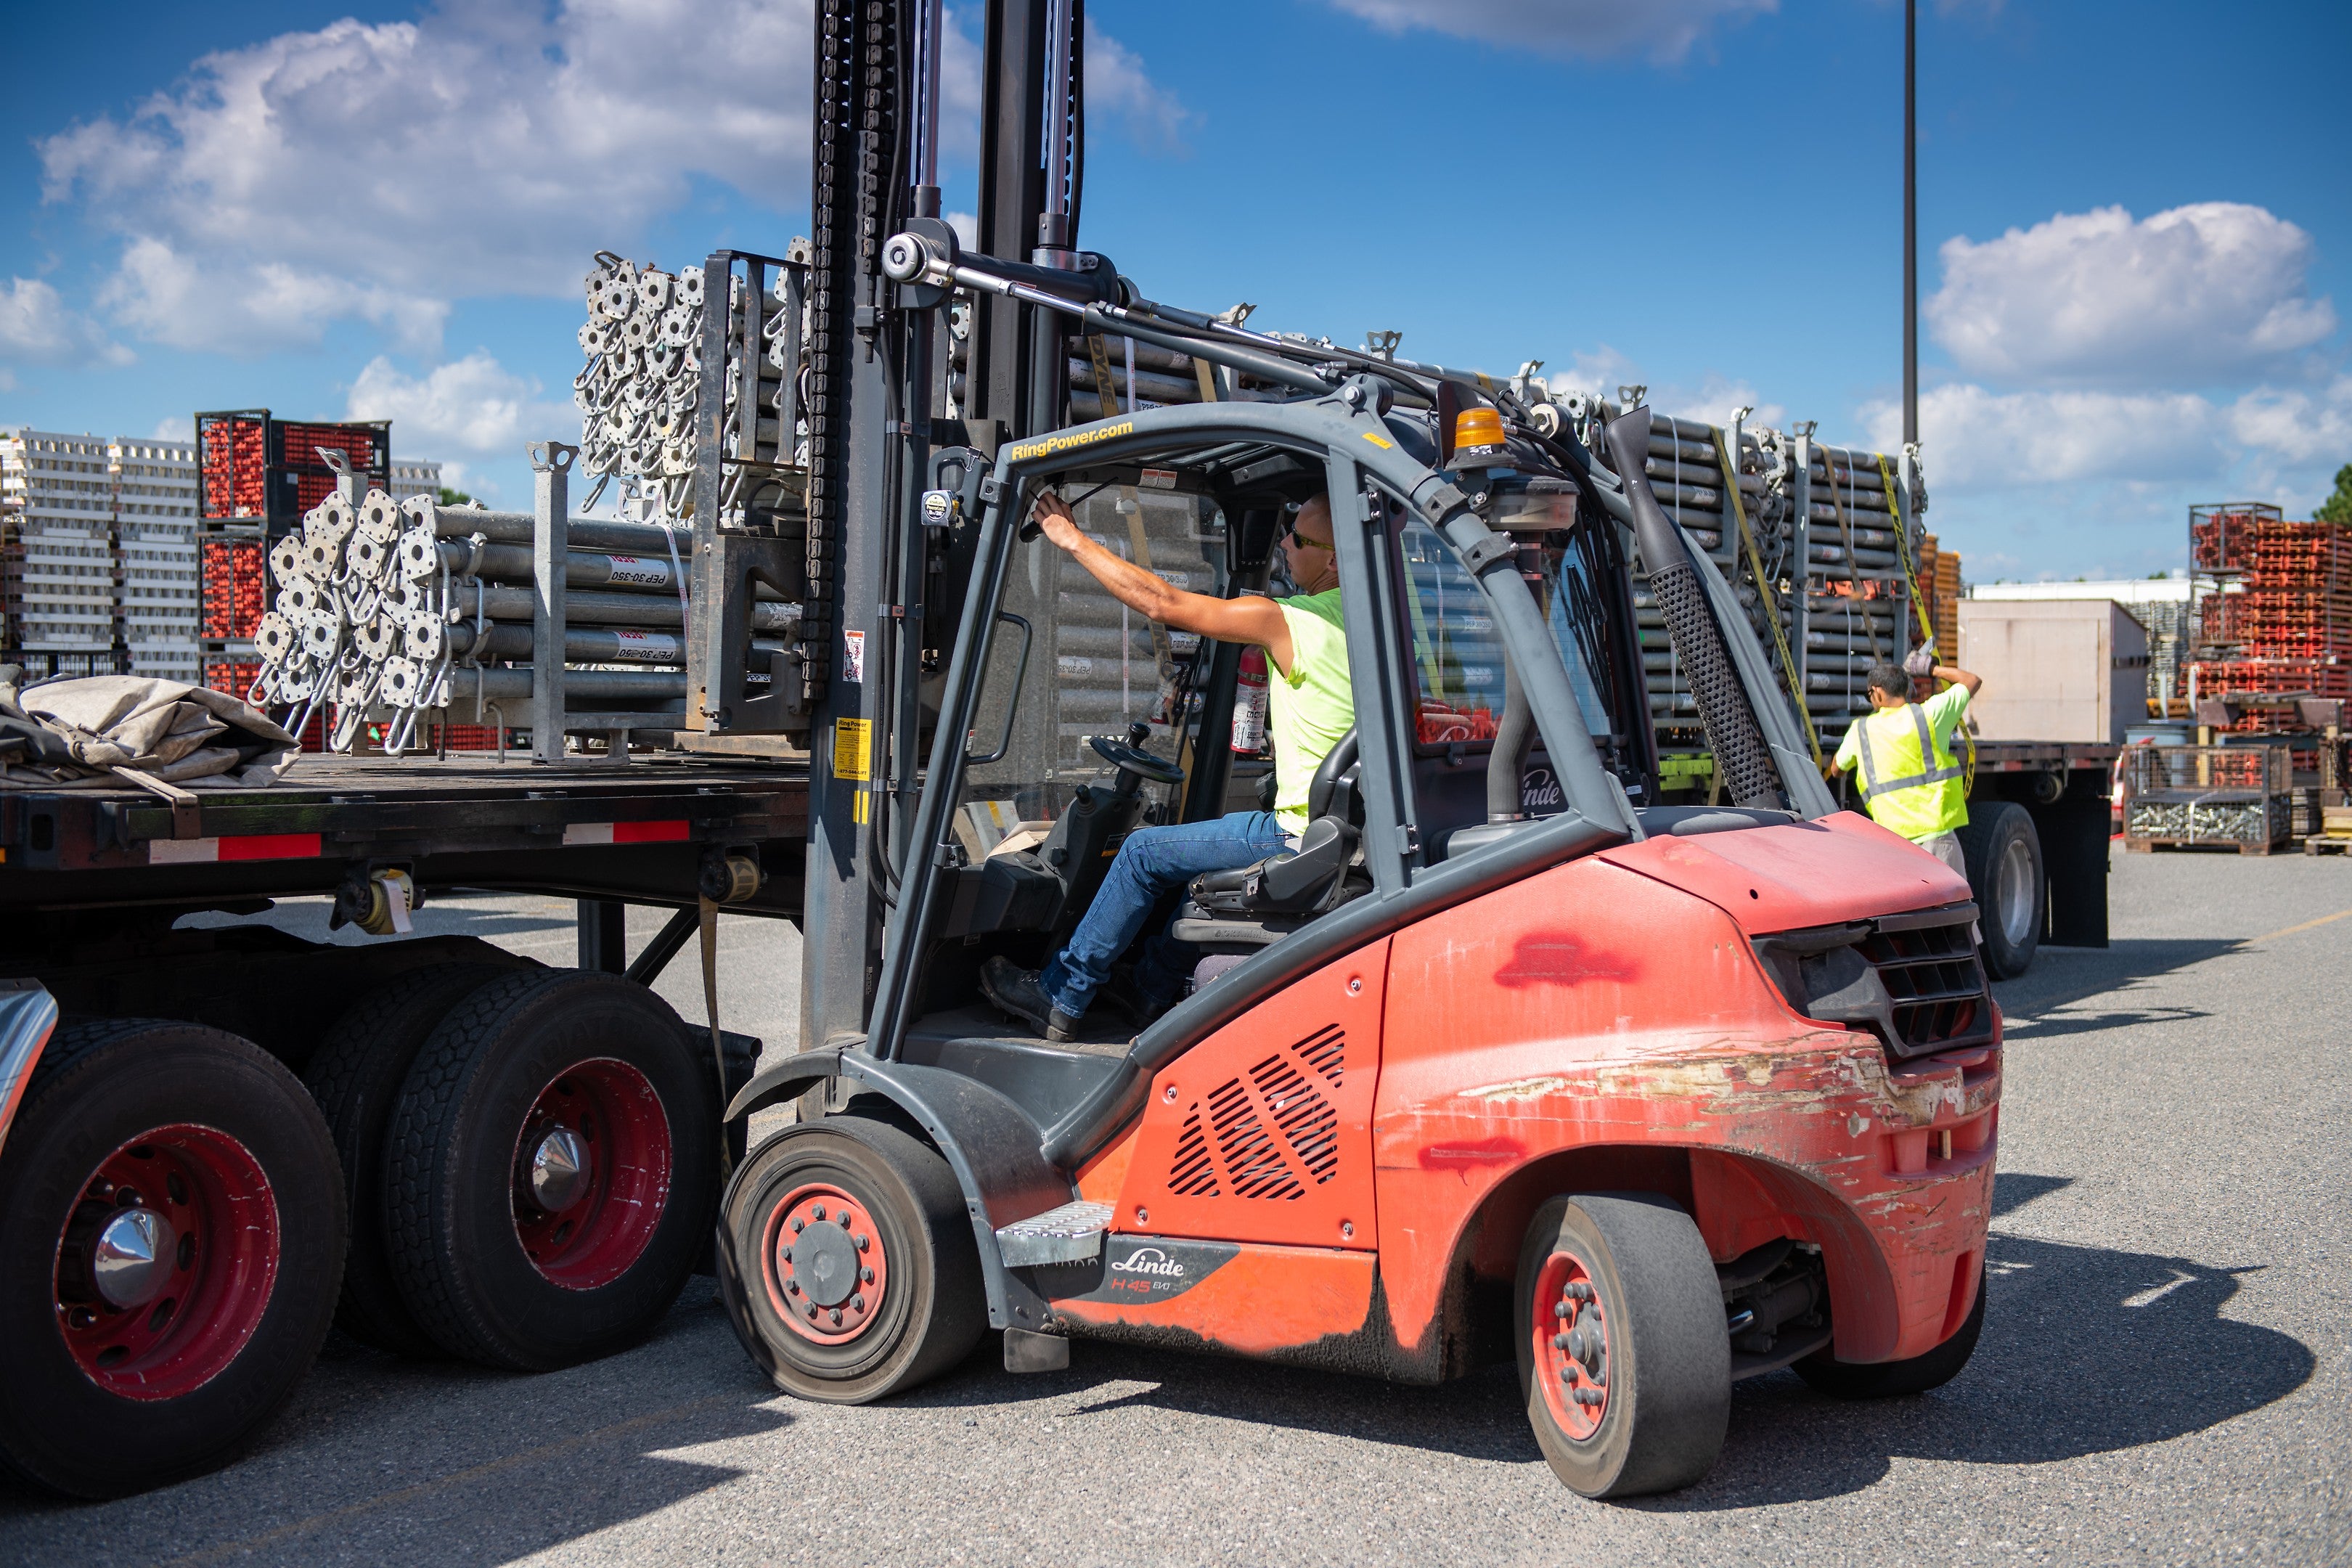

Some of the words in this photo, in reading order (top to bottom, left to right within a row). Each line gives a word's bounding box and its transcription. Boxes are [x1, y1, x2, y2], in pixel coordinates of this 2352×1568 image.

[1089, 333, 1116, 404] DYNE
[1012, 422, 1132, 460] RingPower.com
[1892, 515, 1918, 592] ANCRA
[611, 571, 645, 582] 30-350
[646, 575, 666, 584] PEP
[1224, 930, 1274, 940] GRAMMER
[1111, 1248, 1184, 1277] Linde
[1153, 1281, 1170, 1290] EVO
